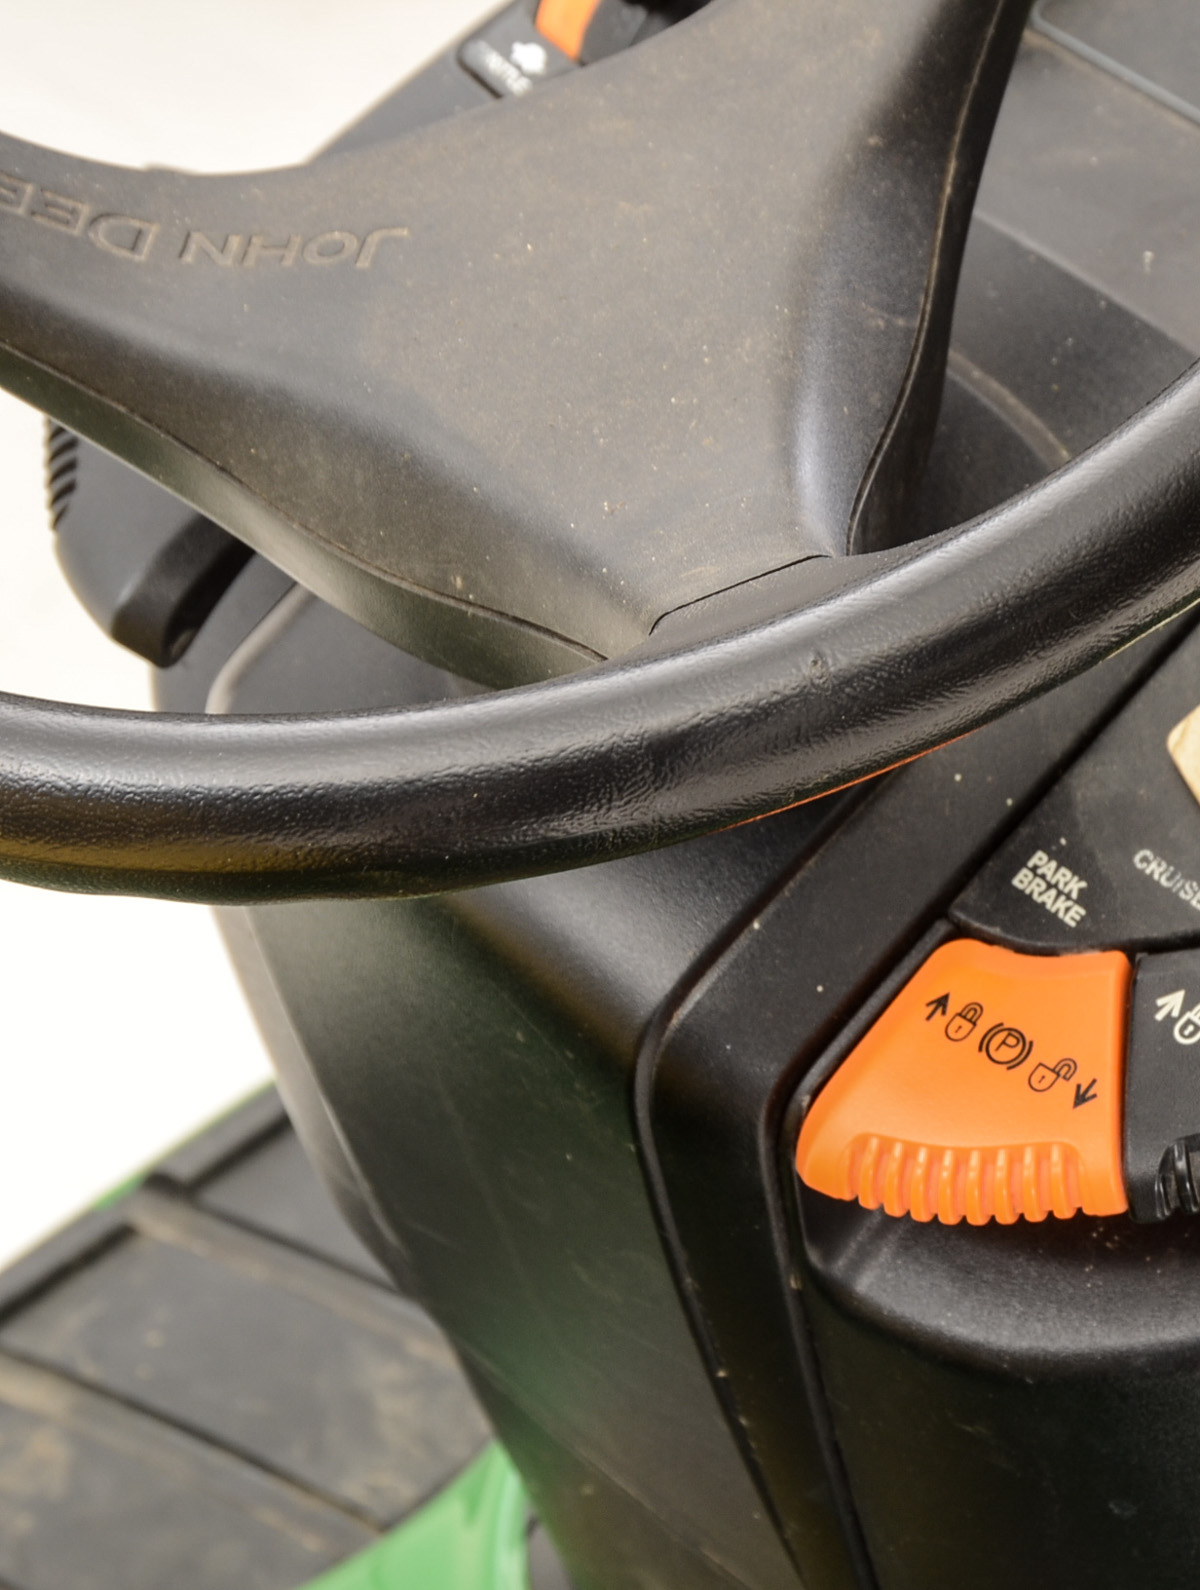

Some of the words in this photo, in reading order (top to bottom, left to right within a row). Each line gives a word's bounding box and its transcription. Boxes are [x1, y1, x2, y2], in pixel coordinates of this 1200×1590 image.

[178, 226, 410, 269] JOHN
[1011, 867, 1087, 928] BRAKE
[1026, 850, 1088, 900] PARK
